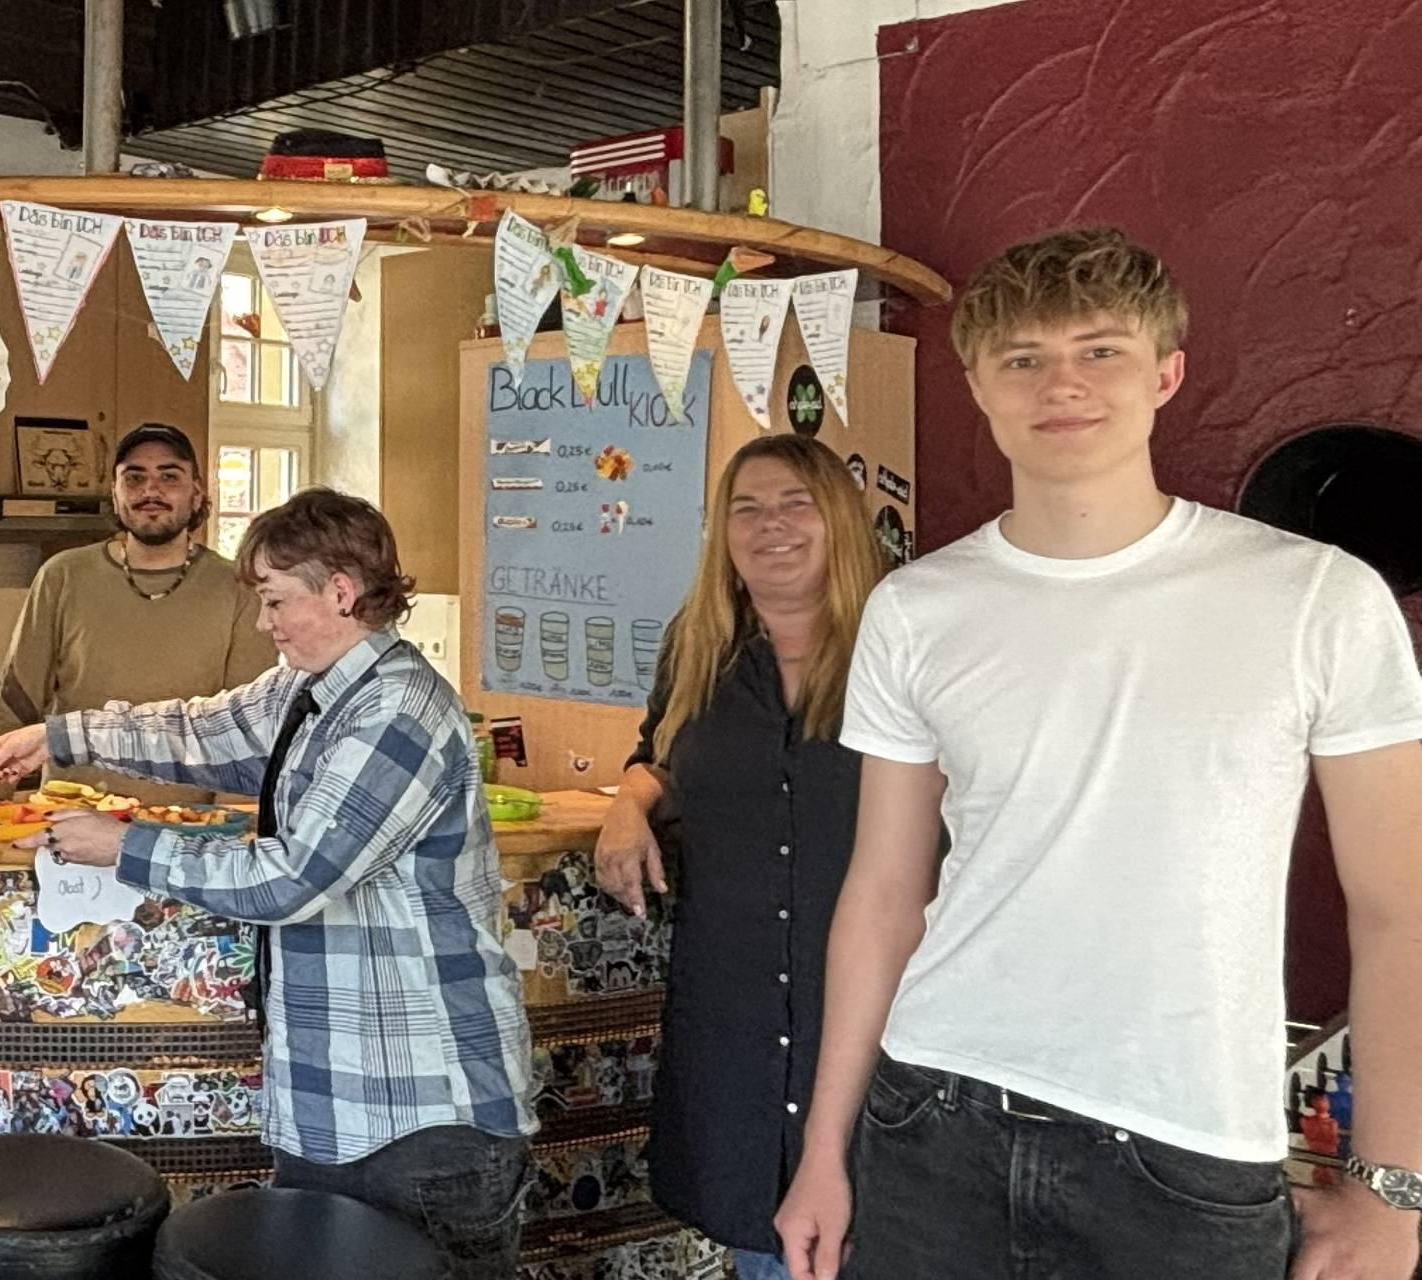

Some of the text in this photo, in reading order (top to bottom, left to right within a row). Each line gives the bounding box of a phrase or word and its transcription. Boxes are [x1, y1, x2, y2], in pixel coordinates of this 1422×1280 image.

[19, 205, 103, 234] Das bin ICH
[140, 223, 168, 240] Das
[264, 229, 292, 247] Das
[295, 229, 318, 246] bin
[628, 390, 696, 428] KIOK
[490, 564, 609, 600] GETRÄNKE
